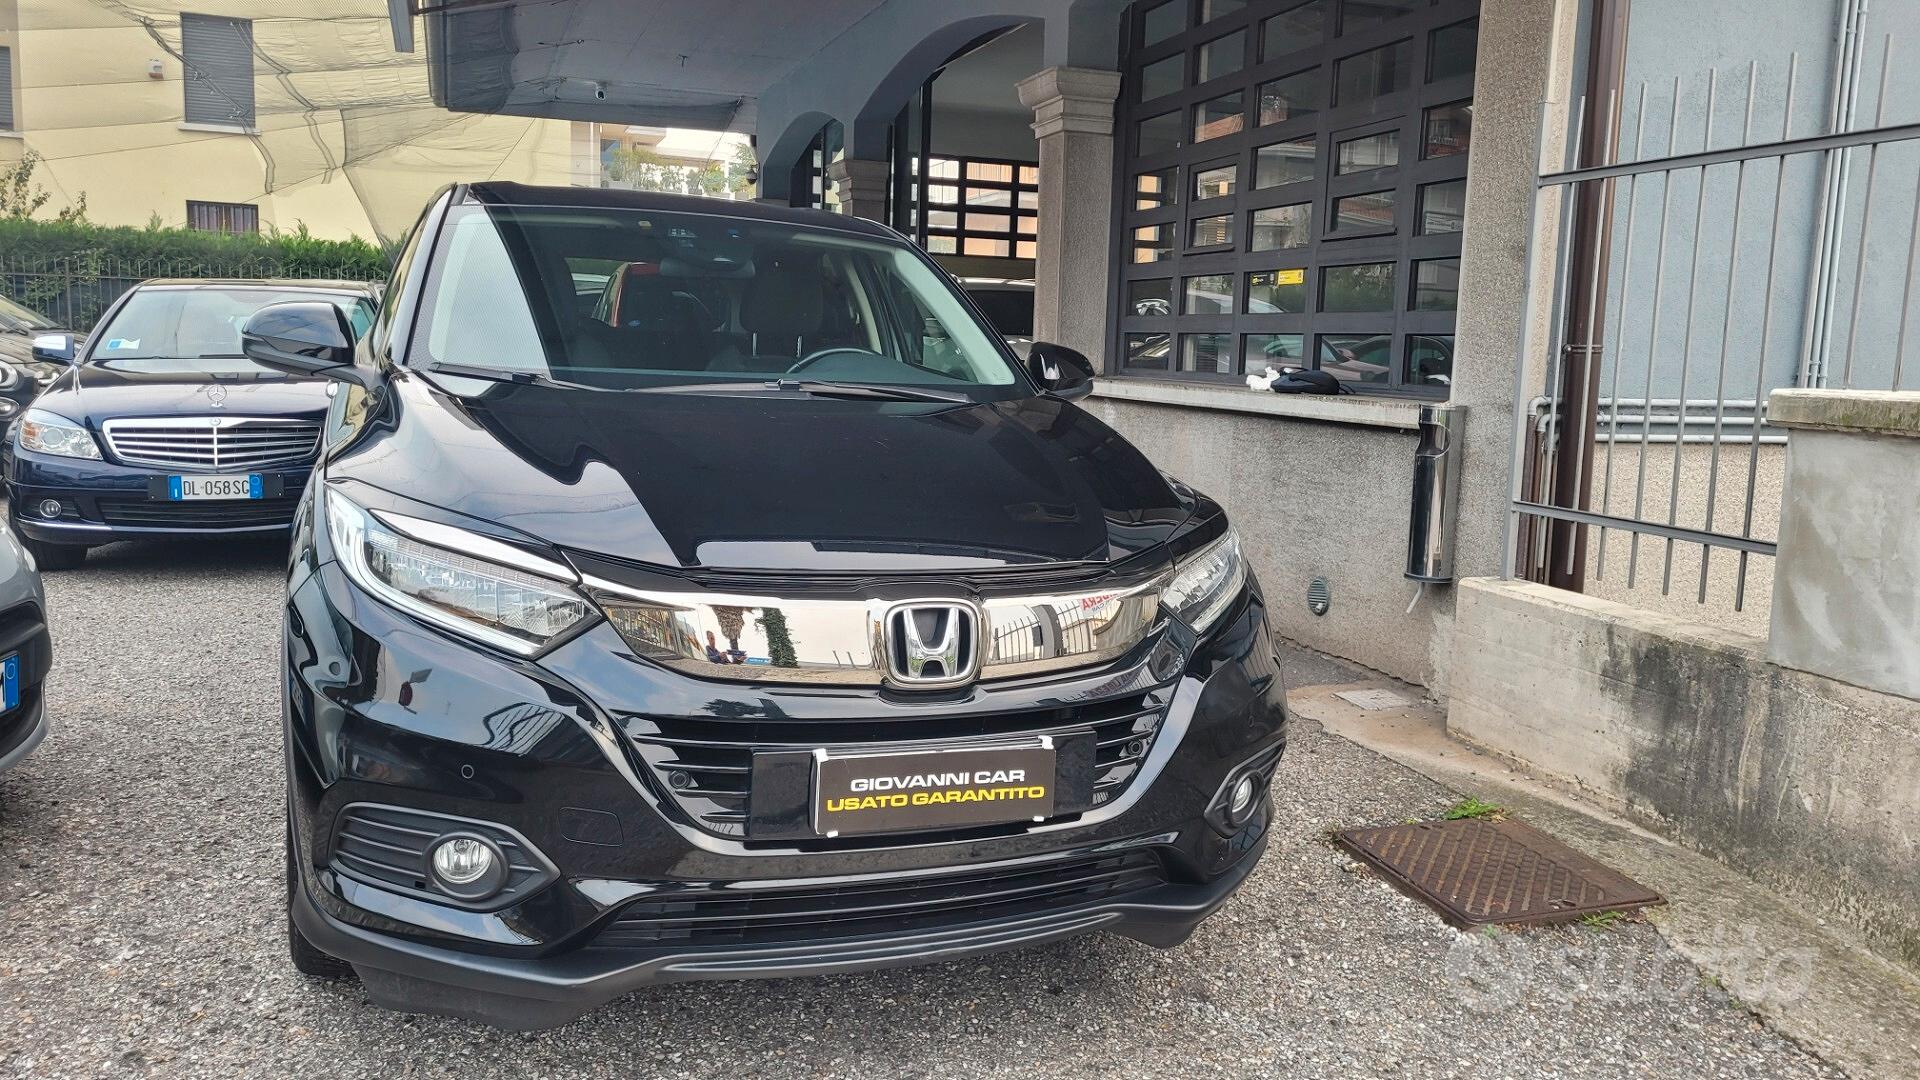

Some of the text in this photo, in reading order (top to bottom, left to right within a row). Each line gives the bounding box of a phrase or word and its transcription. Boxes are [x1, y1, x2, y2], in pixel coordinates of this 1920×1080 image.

[850, 769, 1026, 792] GIOVANNI CAR
[827, 786, 1046, 812] USATO GARANTITO
